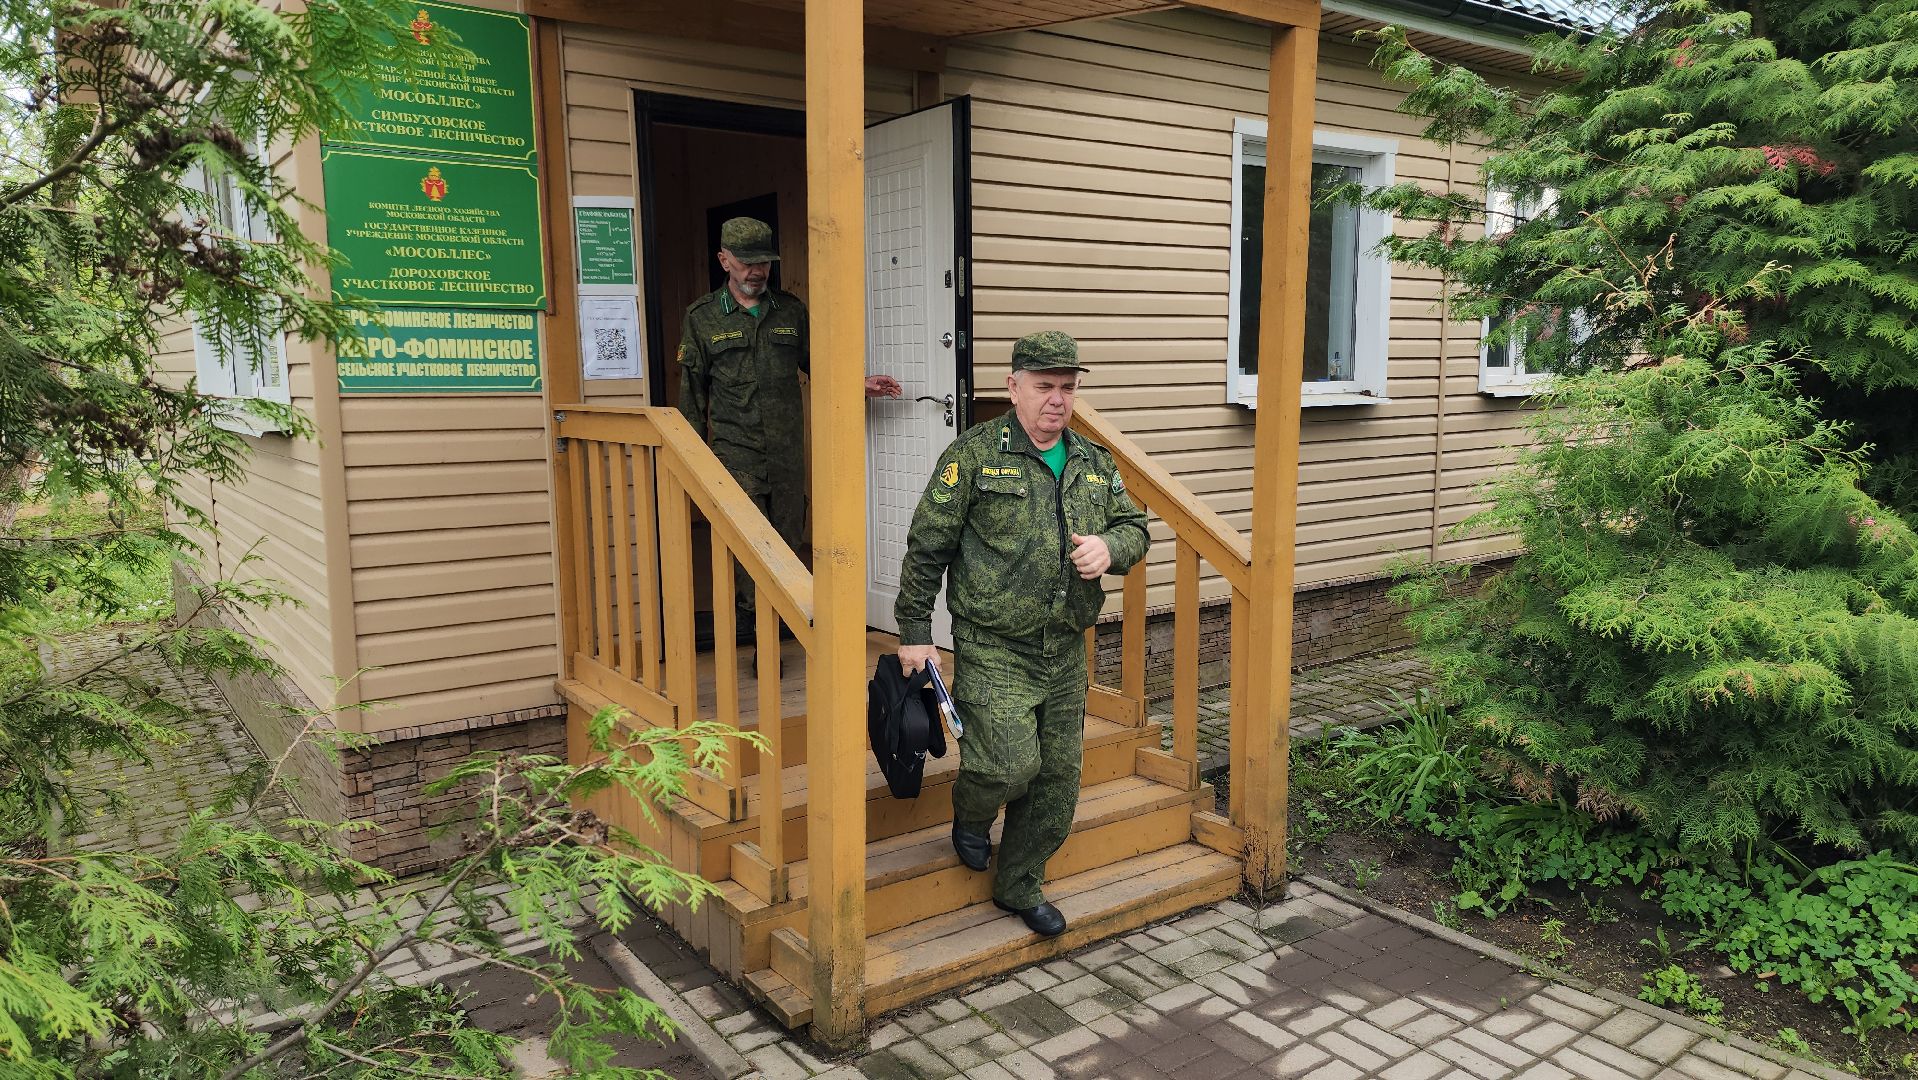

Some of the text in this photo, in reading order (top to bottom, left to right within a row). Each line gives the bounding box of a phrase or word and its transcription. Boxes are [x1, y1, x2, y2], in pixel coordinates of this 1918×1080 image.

[472, 85, 516, 97] ОБЛАСТИ
[371, 109, 486, 131] СИМБУХОВСКОЕ
[428, 128, 525, 147] ЛЕСНИЧЕСТВО
[368, 201, 501, 217] КОМИТЕТ ЛЕСНОГО ХОЗЯЙСТВА
[386, 210, 486, 223] МОСКОВСКОЙ ОБЛАСТИ
[364, 222, 508, 237] ГОСУДАРСТВЕННОЕ КАЗЕННОЕ
[346, 229, 525, 246] УЧРЕЖДЕНИЕ МОСКОВСКОЙ ОБЛАСТИ
[384, 246, 492, 261] «МОСОБЛЛЕС»
[389, 267, 491, 281] ДОРОХОВСКОЕ
[341, 278, 535, 294] УЧАСТКОВОЕ ЛЕСНИЧЕСТВО
[453, 312, 534, 330] ЛЕСНИЧЕСТВО
[337, 362, 537, 377] СЕЛЬСКОЕ УЧАСТКОВОЕ ЛЕСНИЧЕСТВО
